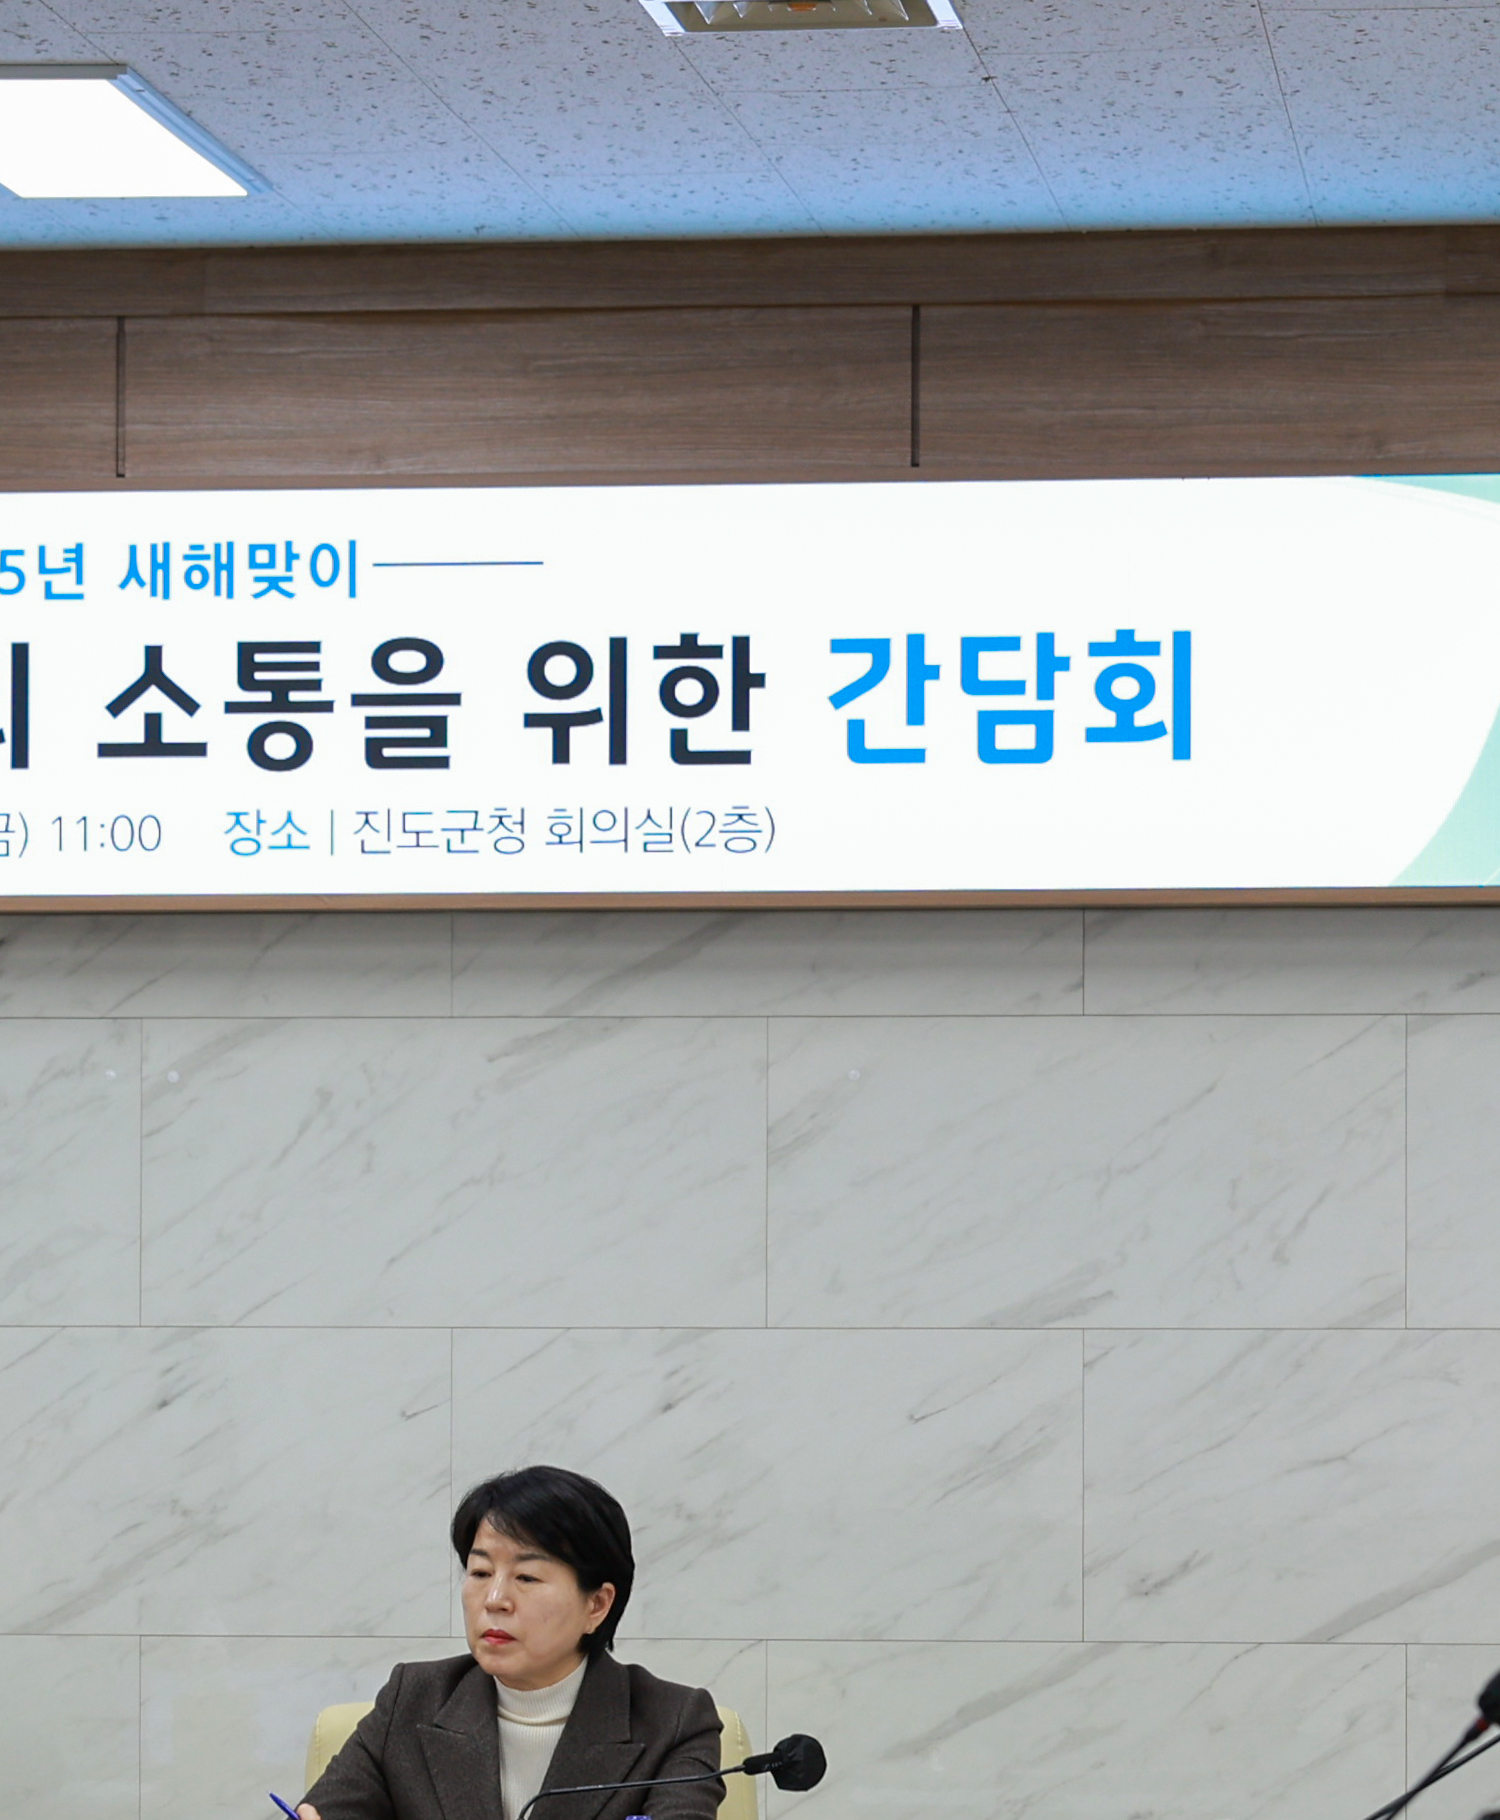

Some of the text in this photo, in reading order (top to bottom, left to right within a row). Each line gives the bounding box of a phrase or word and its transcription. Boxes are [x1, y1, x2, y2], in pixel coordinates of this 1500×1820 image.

[118, 539, 357, 601] 새해맞이
[95, 635, 463, 774] 소통을
[522, 631, 768, 767] 위한
[827, 627, 1193, 766] 간담회
[50, 814, 162, 853] 11:00
[223, 809, 311, 858] 장소
[353, 806, 525, 856] 진도군청
[544, 805, 777, 854] 회의실(2층)
